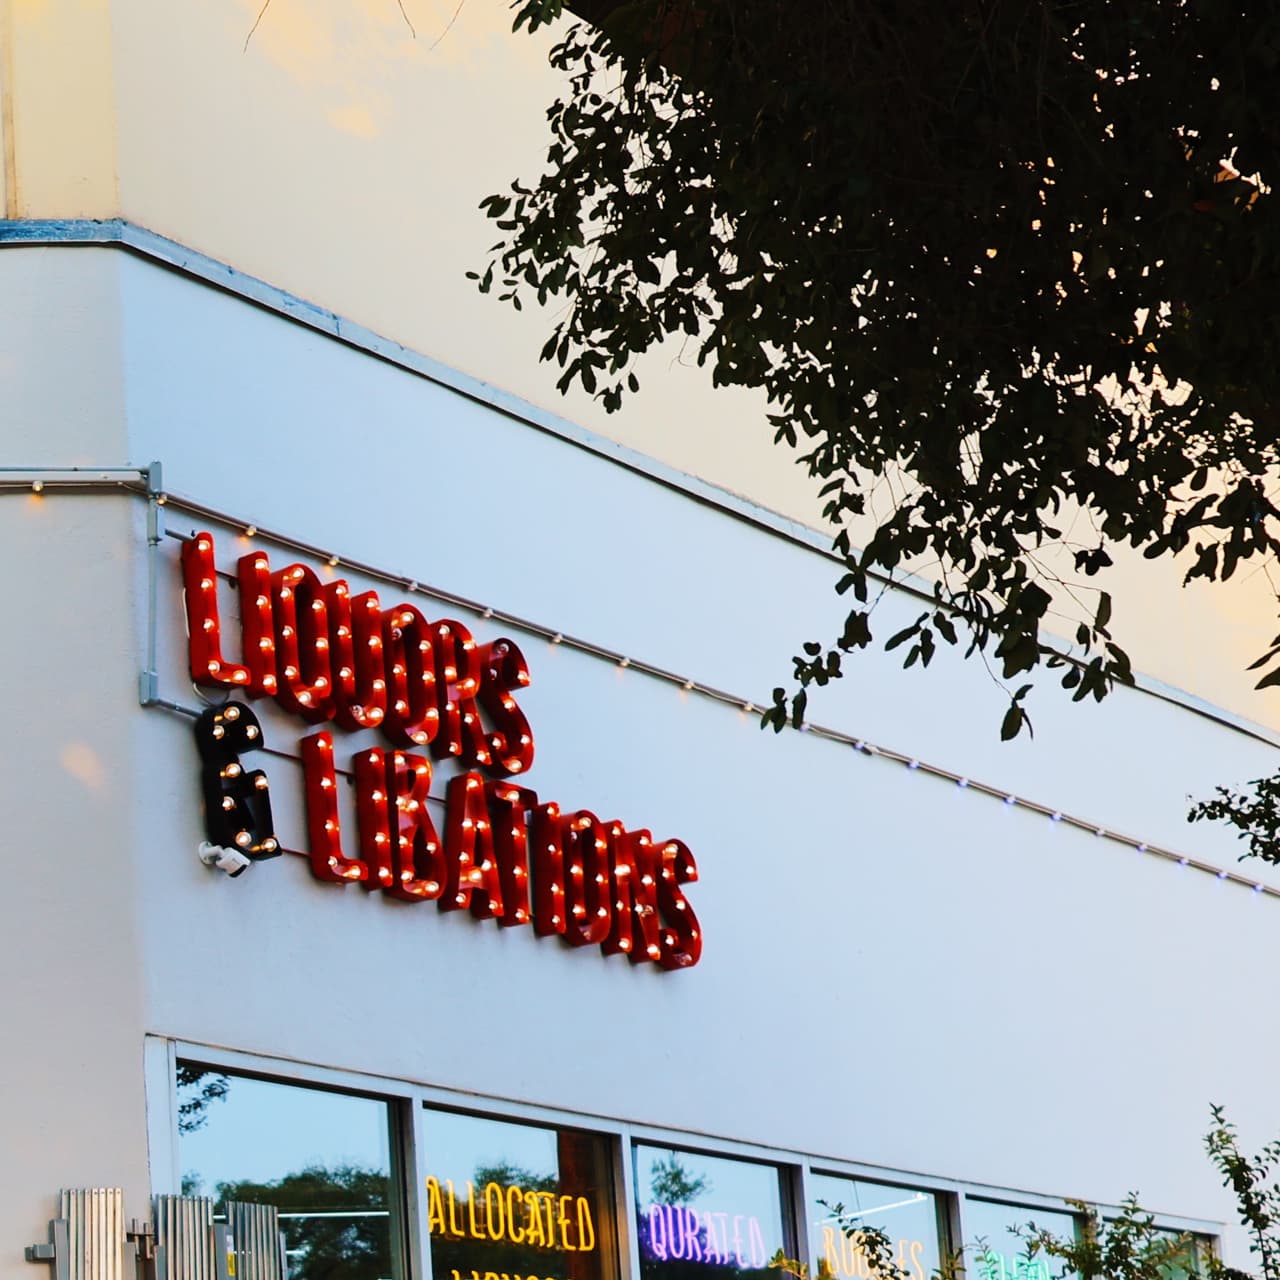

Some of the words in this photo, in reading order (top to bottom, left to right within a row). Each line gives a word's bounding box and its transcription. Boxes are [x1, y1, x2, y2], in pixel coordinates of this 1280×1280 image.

[181, 531, 535, 777] LIQUORS
[300, 731, 703, 970] LIBATIONS
[426, 1175, 595, 1251] ALLOCATED
